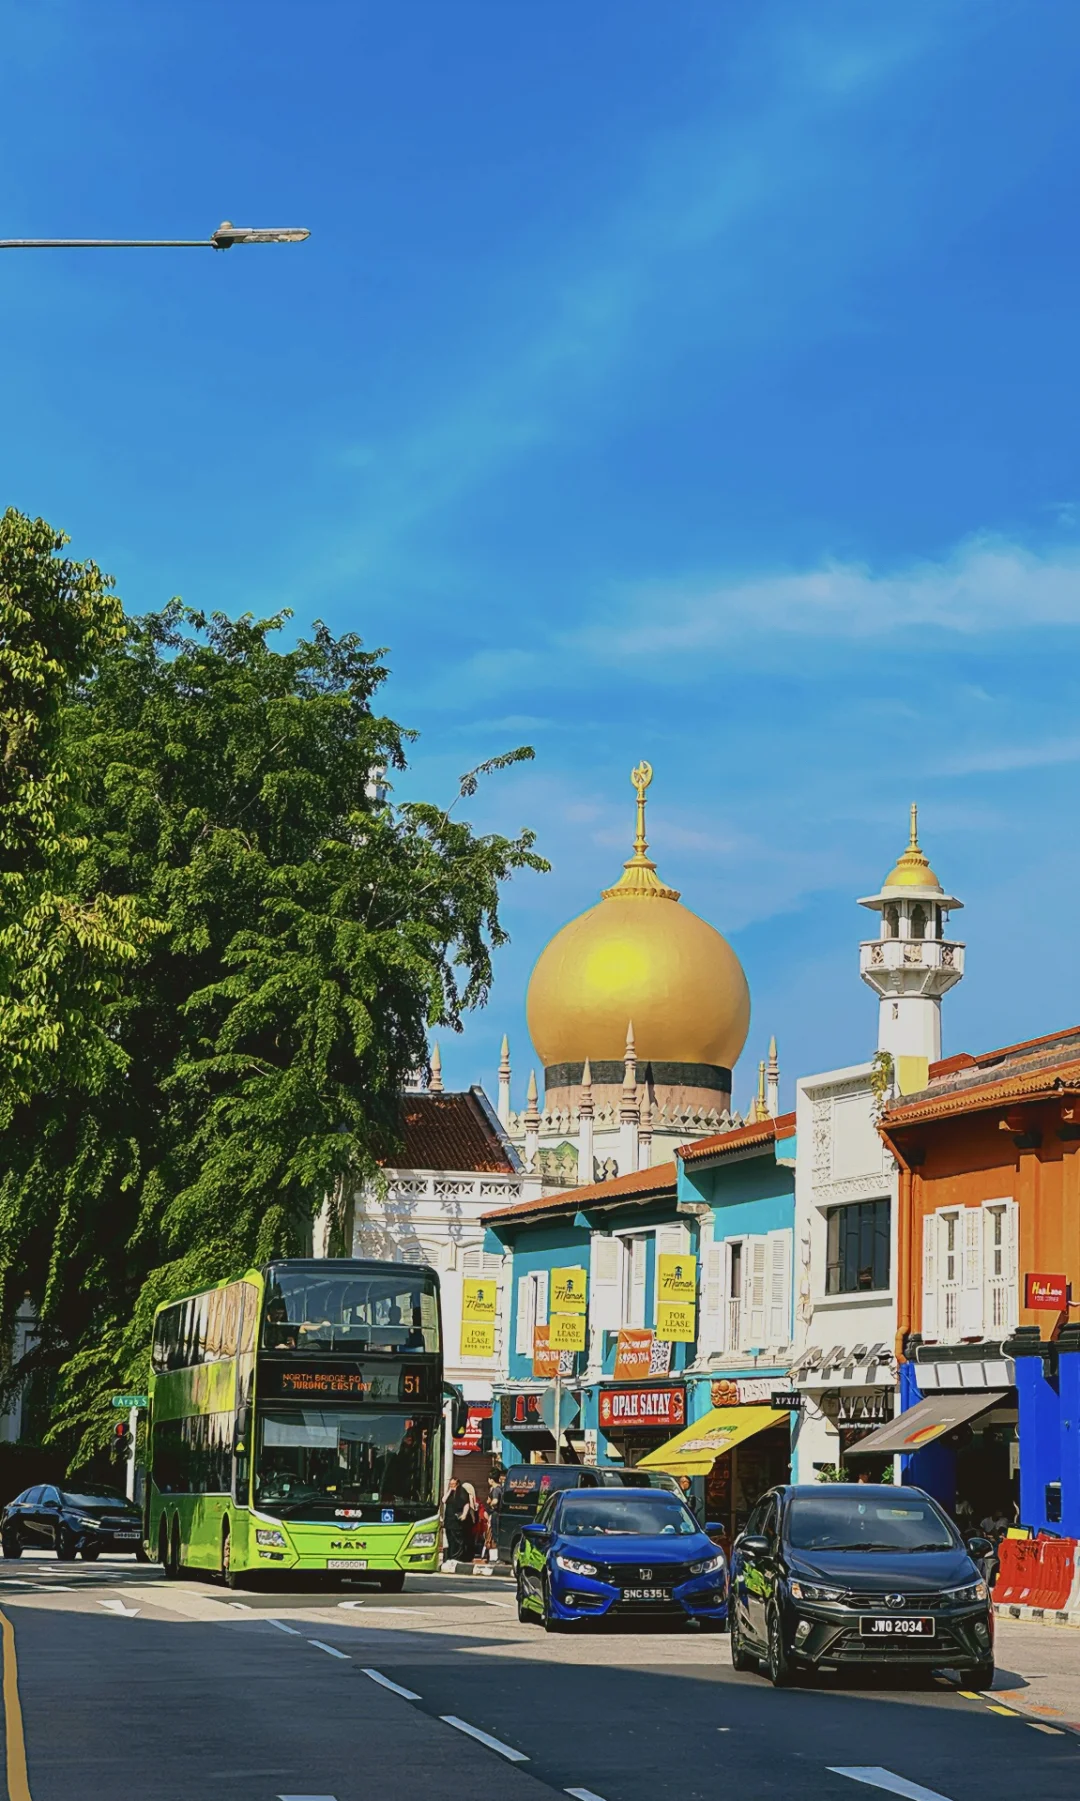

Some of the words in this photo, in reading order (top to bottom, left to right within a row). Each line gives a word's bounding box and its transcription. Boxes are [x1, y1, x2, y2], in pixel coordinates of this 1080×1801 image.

[669, 1311, 685, 1319] FOR
[557, 1330, 580, 1338] LEASE
[466, 1336, 490, 1344] LEASE
[315, 1374, 346, 1382] BRIDGE
[349, 1375, 361, 1383] RD
[293, 1381, 327, 1390] JURONG
[331, 1382, 353, 1390] EAST
[358, 1382, 372, 1391] INT
[404, 1376, 420, 1393] 51
[117, 1398, 139, 1406] Arab
[612, 1394, 638, 1417] OPAH
[640, 1392, 671, 1416] SATAY
[775, 1397, 799, 1405] XVXII
[871, 1620, 892, 1632] JWQ
[894, 1620, 923, 1633] 2034
